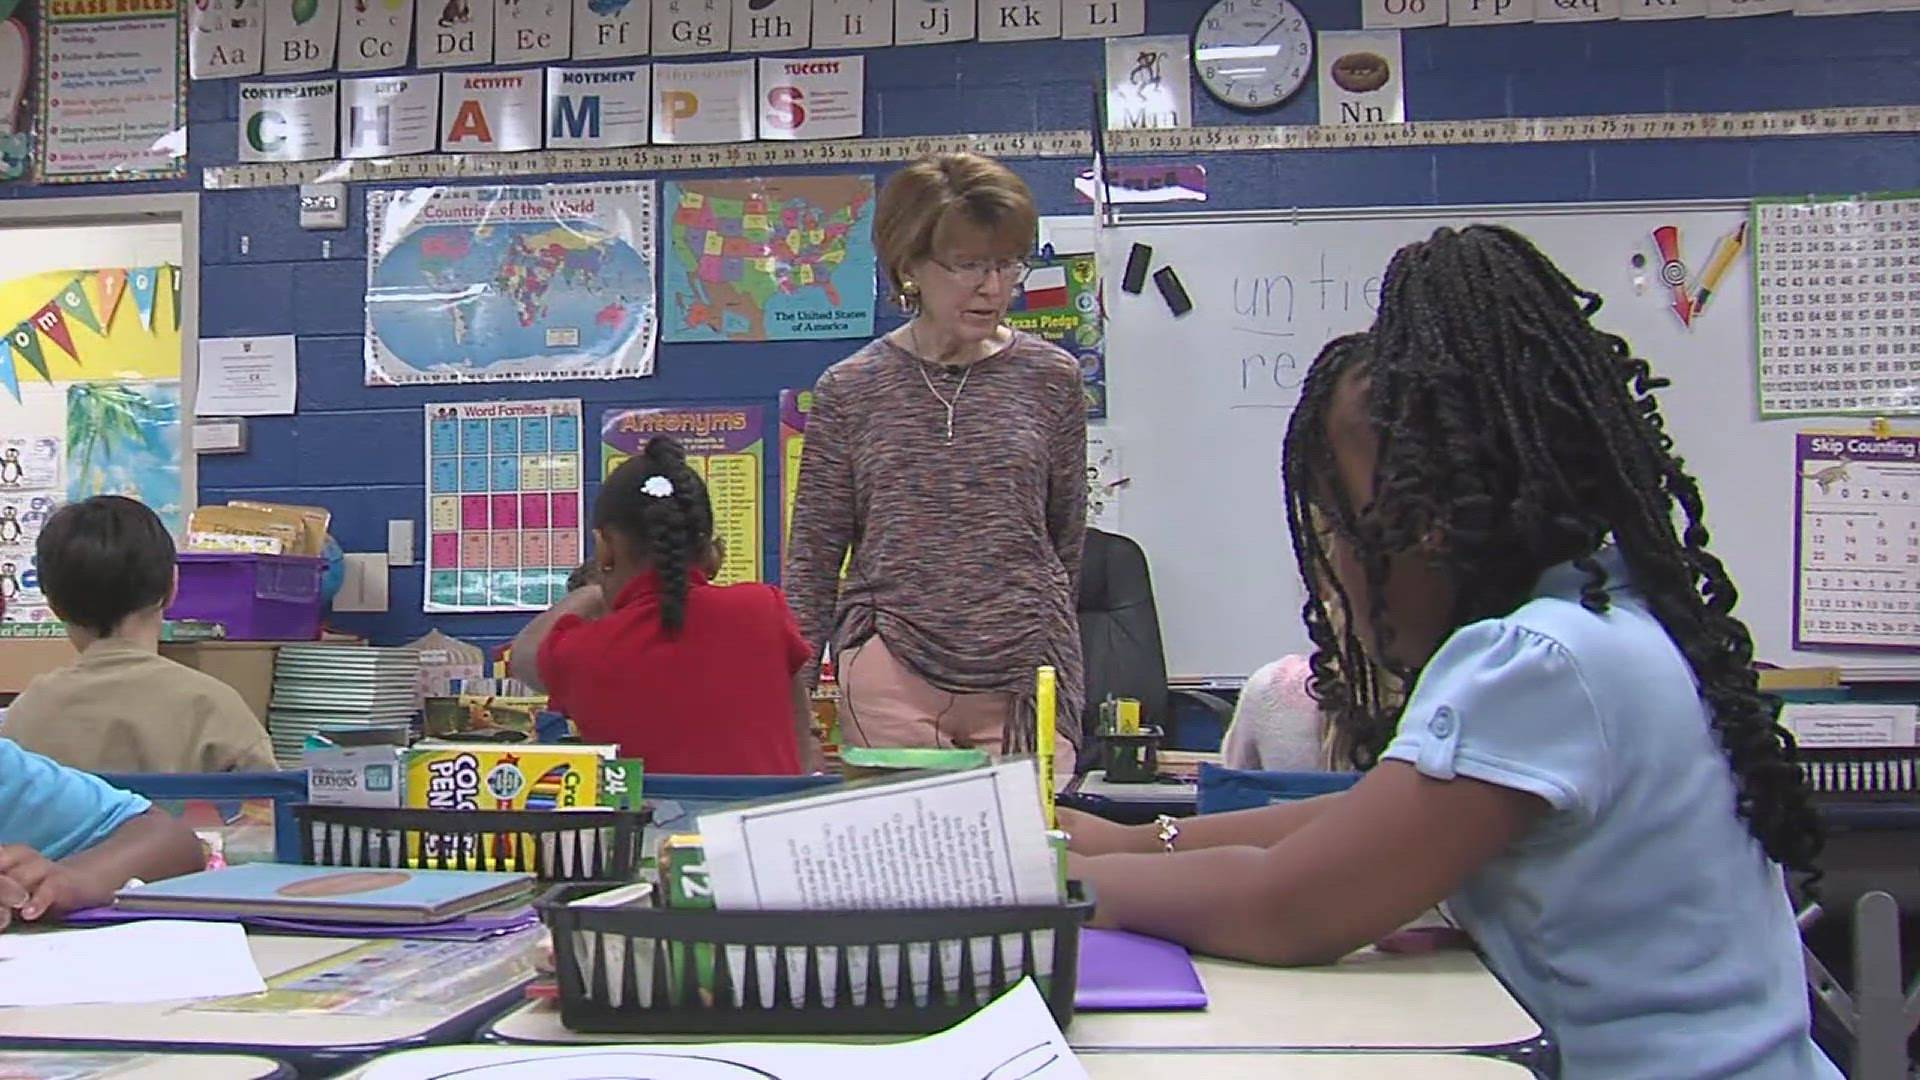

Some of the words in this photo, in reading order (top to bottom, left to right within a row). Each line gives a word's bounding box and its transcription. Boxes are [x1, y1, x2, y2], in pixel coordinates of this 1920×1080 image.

[750, 15, 792, 39] Hh
[920, 7, 950, 36] Jj
[999, 4, 1042, 29] Kk
[1293, 18, 1302, 32] 2
[436, 31, 475, 54] Dd
[517, 28, 551, 50] Ee
[597, 22, 630, 45] Ff
[671, 20, 713, 47] Gg
[209, 45, 246, 66] Aa
[283, 39, 320, 61] Bb
[359, 36, 394, 59] Cc
[1298, 42, 1308, 56] 3
[562, 71, 636, 85] MOVEMENT
[783, 62, 840, 75] SUCCESS
[463, 76, 523, 90] ACTIVITY
[1224, 80, 1237, 97] 7
[1273, 83, 1283, 98] 5
[1248, 89, 1258, 103] 6
[552, 94, 600, 138] M
[660, 91, 698, 135] P
[766, 86, 806, 130] S
[1339, 101, 1384, 124] Nn
[246, 109, 287, 153] C
[350, 105, 389, 147] H
[446, 99, 493, 143] A
[424, 202, 494, 219] Countrie
[500, 201, 514, 216] of
[520, 200, 545, 216] the
[1233, 275, 1293, 322] un
[775, 311, 795, 321] The
[797, 310, 833, 320] United
[835, 310, 867, 320] States
[1004, 316, 1038, 329] Texas
[1040, 315, 1079, 330] Pledge
[792, 322, 803, 332] of
[804, 322, 849, 332] America
[463, 405, 496, 417] Word
[499, 404, 547, 416] Families
[620, 411, 747, 436] Antonyms
[1811, 438, 1844, 456] Skip
[1847, 438, 1915, 458] Counting
[312, 774, 358, 787] CRAYONS
[604, 766, 628, 795] 24
